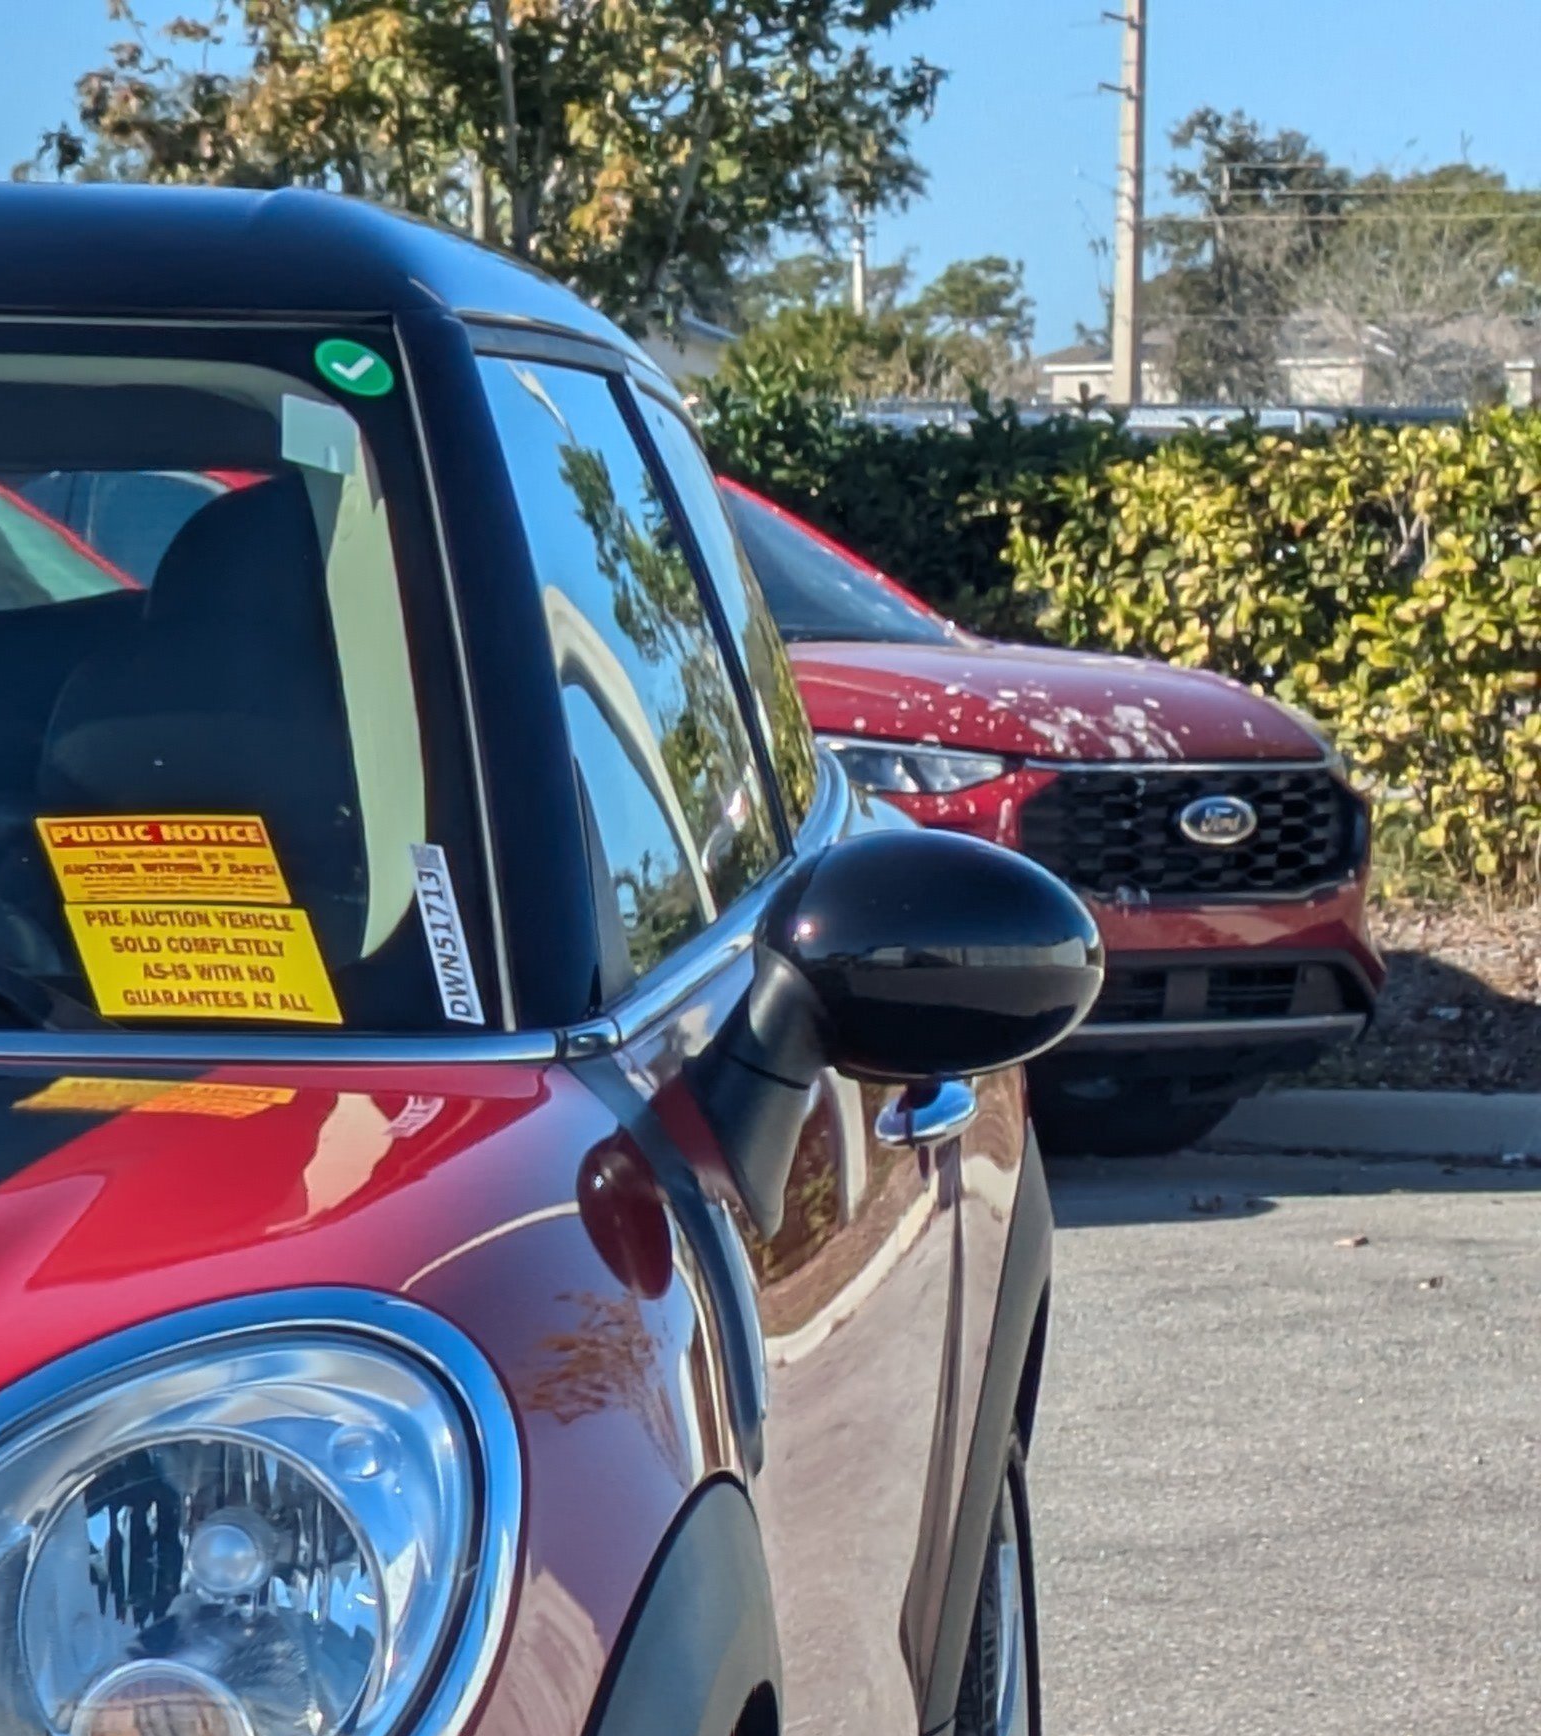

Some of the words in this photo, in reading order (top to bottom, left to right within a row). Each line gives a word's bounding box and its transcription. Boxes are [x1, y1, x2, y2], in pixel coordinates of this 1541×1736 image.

[1200, 807, 1241, 832] Ford
[50, 825, 153, 842] PUBLIC
[160, 824, 262, 842] NOTICE
[63, 862, 136, 875] AUCTION
[83, 909, 212, 927] PRE-AUCTION
[214, 910, 295, 932] VEHICLE
[110, 935, 162, 954] SOLD
[167, 936, 284, 957] COMPLETELY
[418, 869, 472, 1017] DWN51713
[142, 962, 192, 981] AS-IS
[194, 963, 245, 982] WITH
[246, 964, 276, 983] NO
[122, 988, 248, 1008] GUARANTEES
[252, 991, 273, 1010] AT
[278, 992, 314, 1013] ALL
